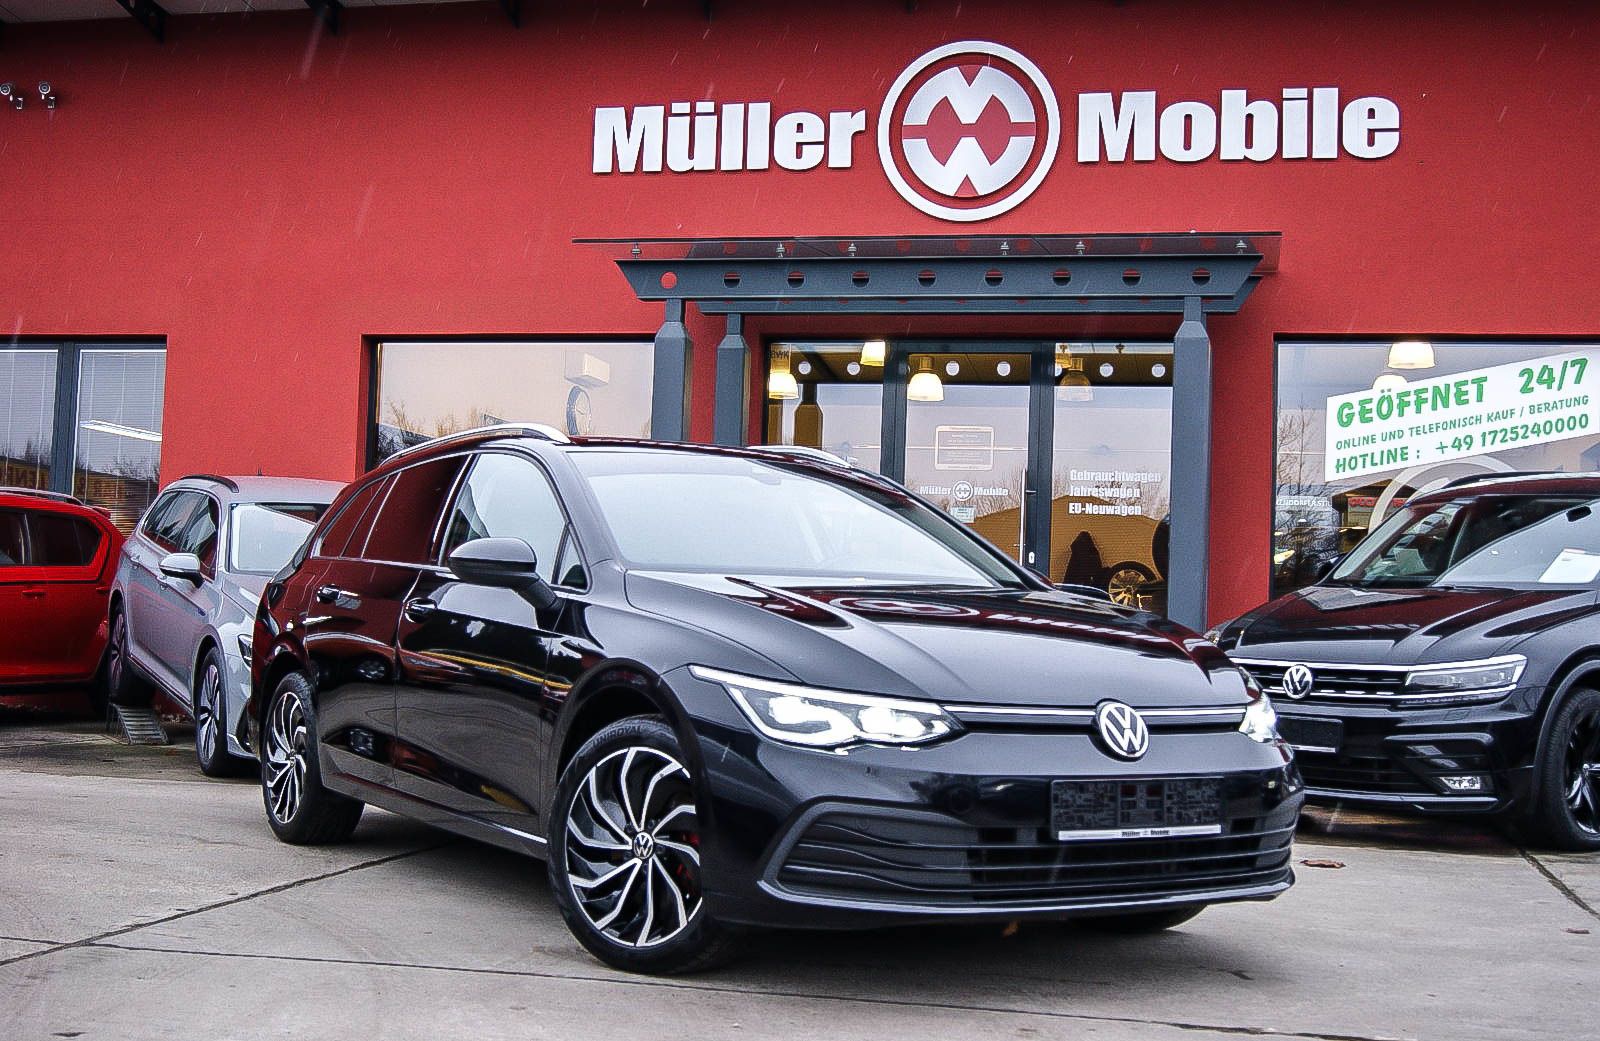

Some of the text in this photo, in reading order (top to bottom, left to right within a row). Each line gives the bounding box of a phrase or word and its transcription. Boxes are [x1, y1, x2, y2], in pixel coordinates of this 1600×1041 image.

[593, 102, 866, 174] Müller
[1078, 87, 1400, 163] Mobile
[1336, 357, 1589, 428] GEÖFFNET 24/7
[1335, 434, 1377, 450] ONLINE
[1381, 429, 1405, 441] UND
[1408, 415, 1482, 437] TELEFONISCH
[1486, 408, 1516, 423] KAUF
[1529, 394, 1589, 415] BERATUNG
[1335, 446, 1409, 474] HOTLINE
[1435, 434, 1474, 456] +49
[1480, 413, 1589, 447] 1725240000
[1069, 468, 1161, 483] Gebrauchtwagen
[1068, 502, 1142, 517] EU-Neuwagen
